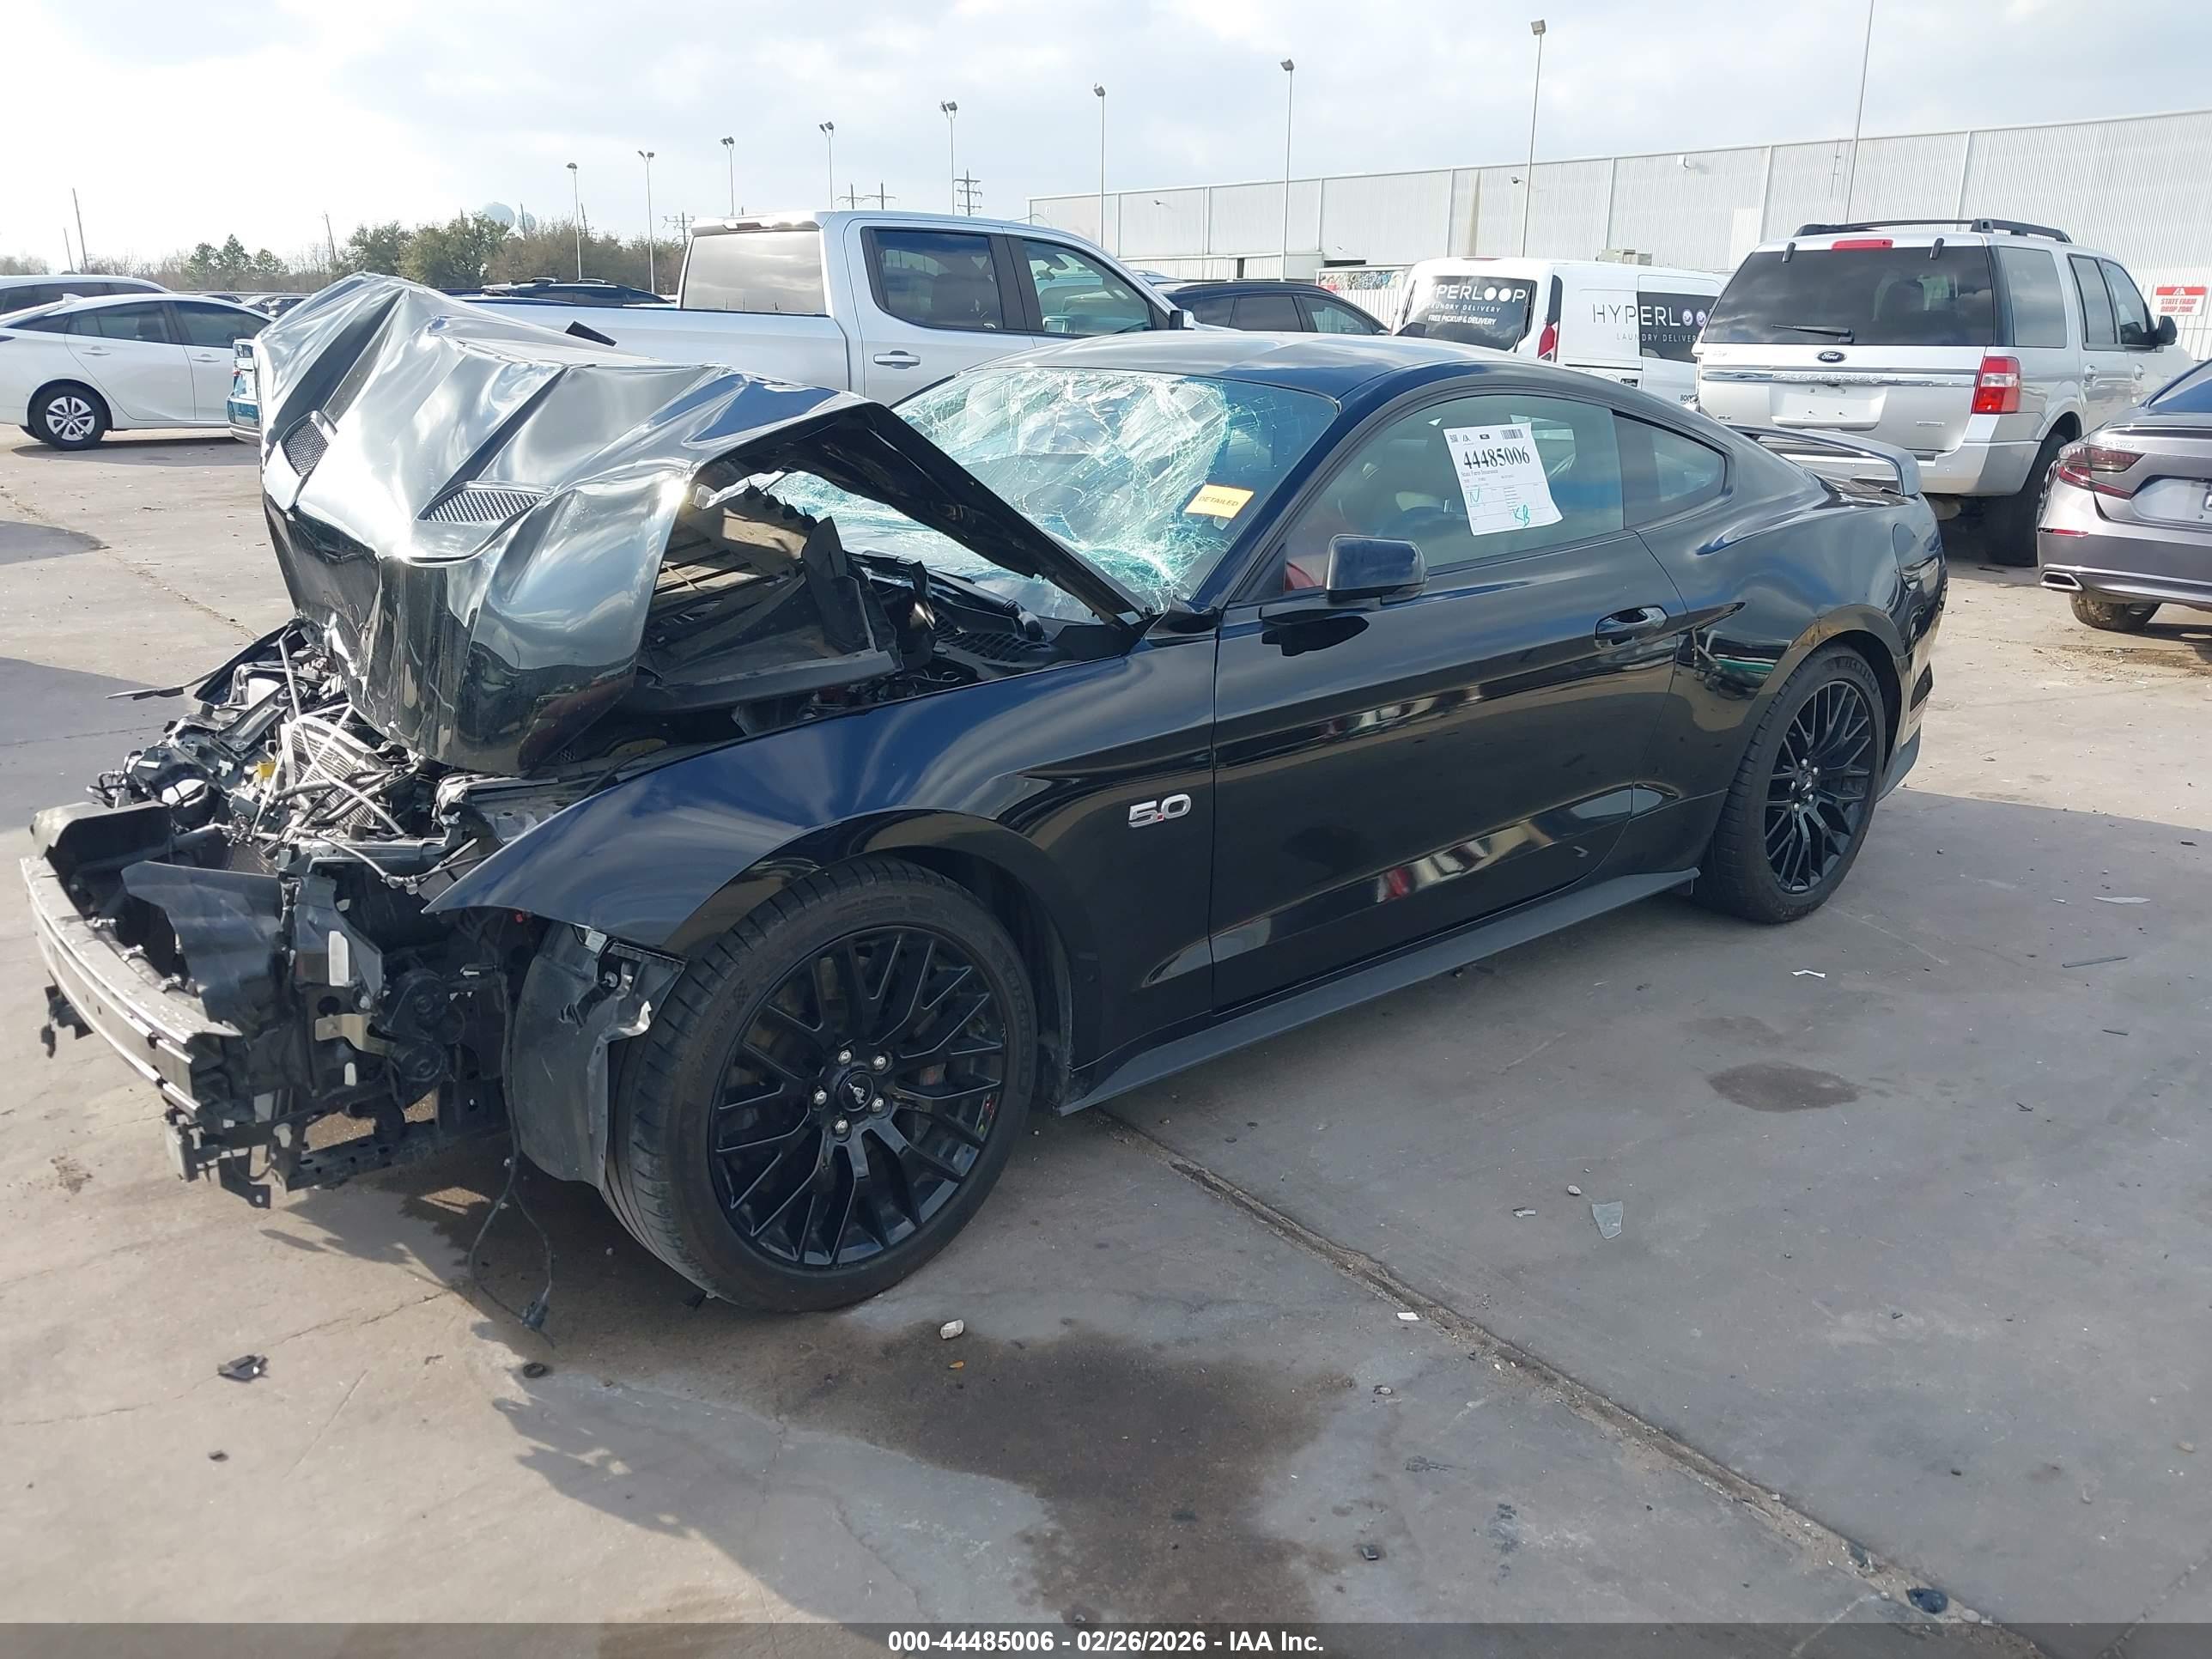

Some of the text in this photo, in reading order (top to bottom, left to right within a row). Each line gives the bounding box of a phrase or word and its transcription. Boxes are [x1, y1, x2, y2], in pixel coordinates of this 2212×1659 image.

[1462, 304, 1502, 313] DELIVERY
[1442, 314, 1462, 324] PICKUP
[1468, 315, 1498, 325] DELIVERY
[1592, 303, 1712, 327] HYPERLOO
[1616, 332, 1697, 343] LAUNDRY DELIVER
[1820, 352, 1840, 361] Ford
[1463, 446, 1530, 470] 44485006
[1198, 496, 1239, 507] DETAILED
[1128, 793, 1192, 828] 5.0
